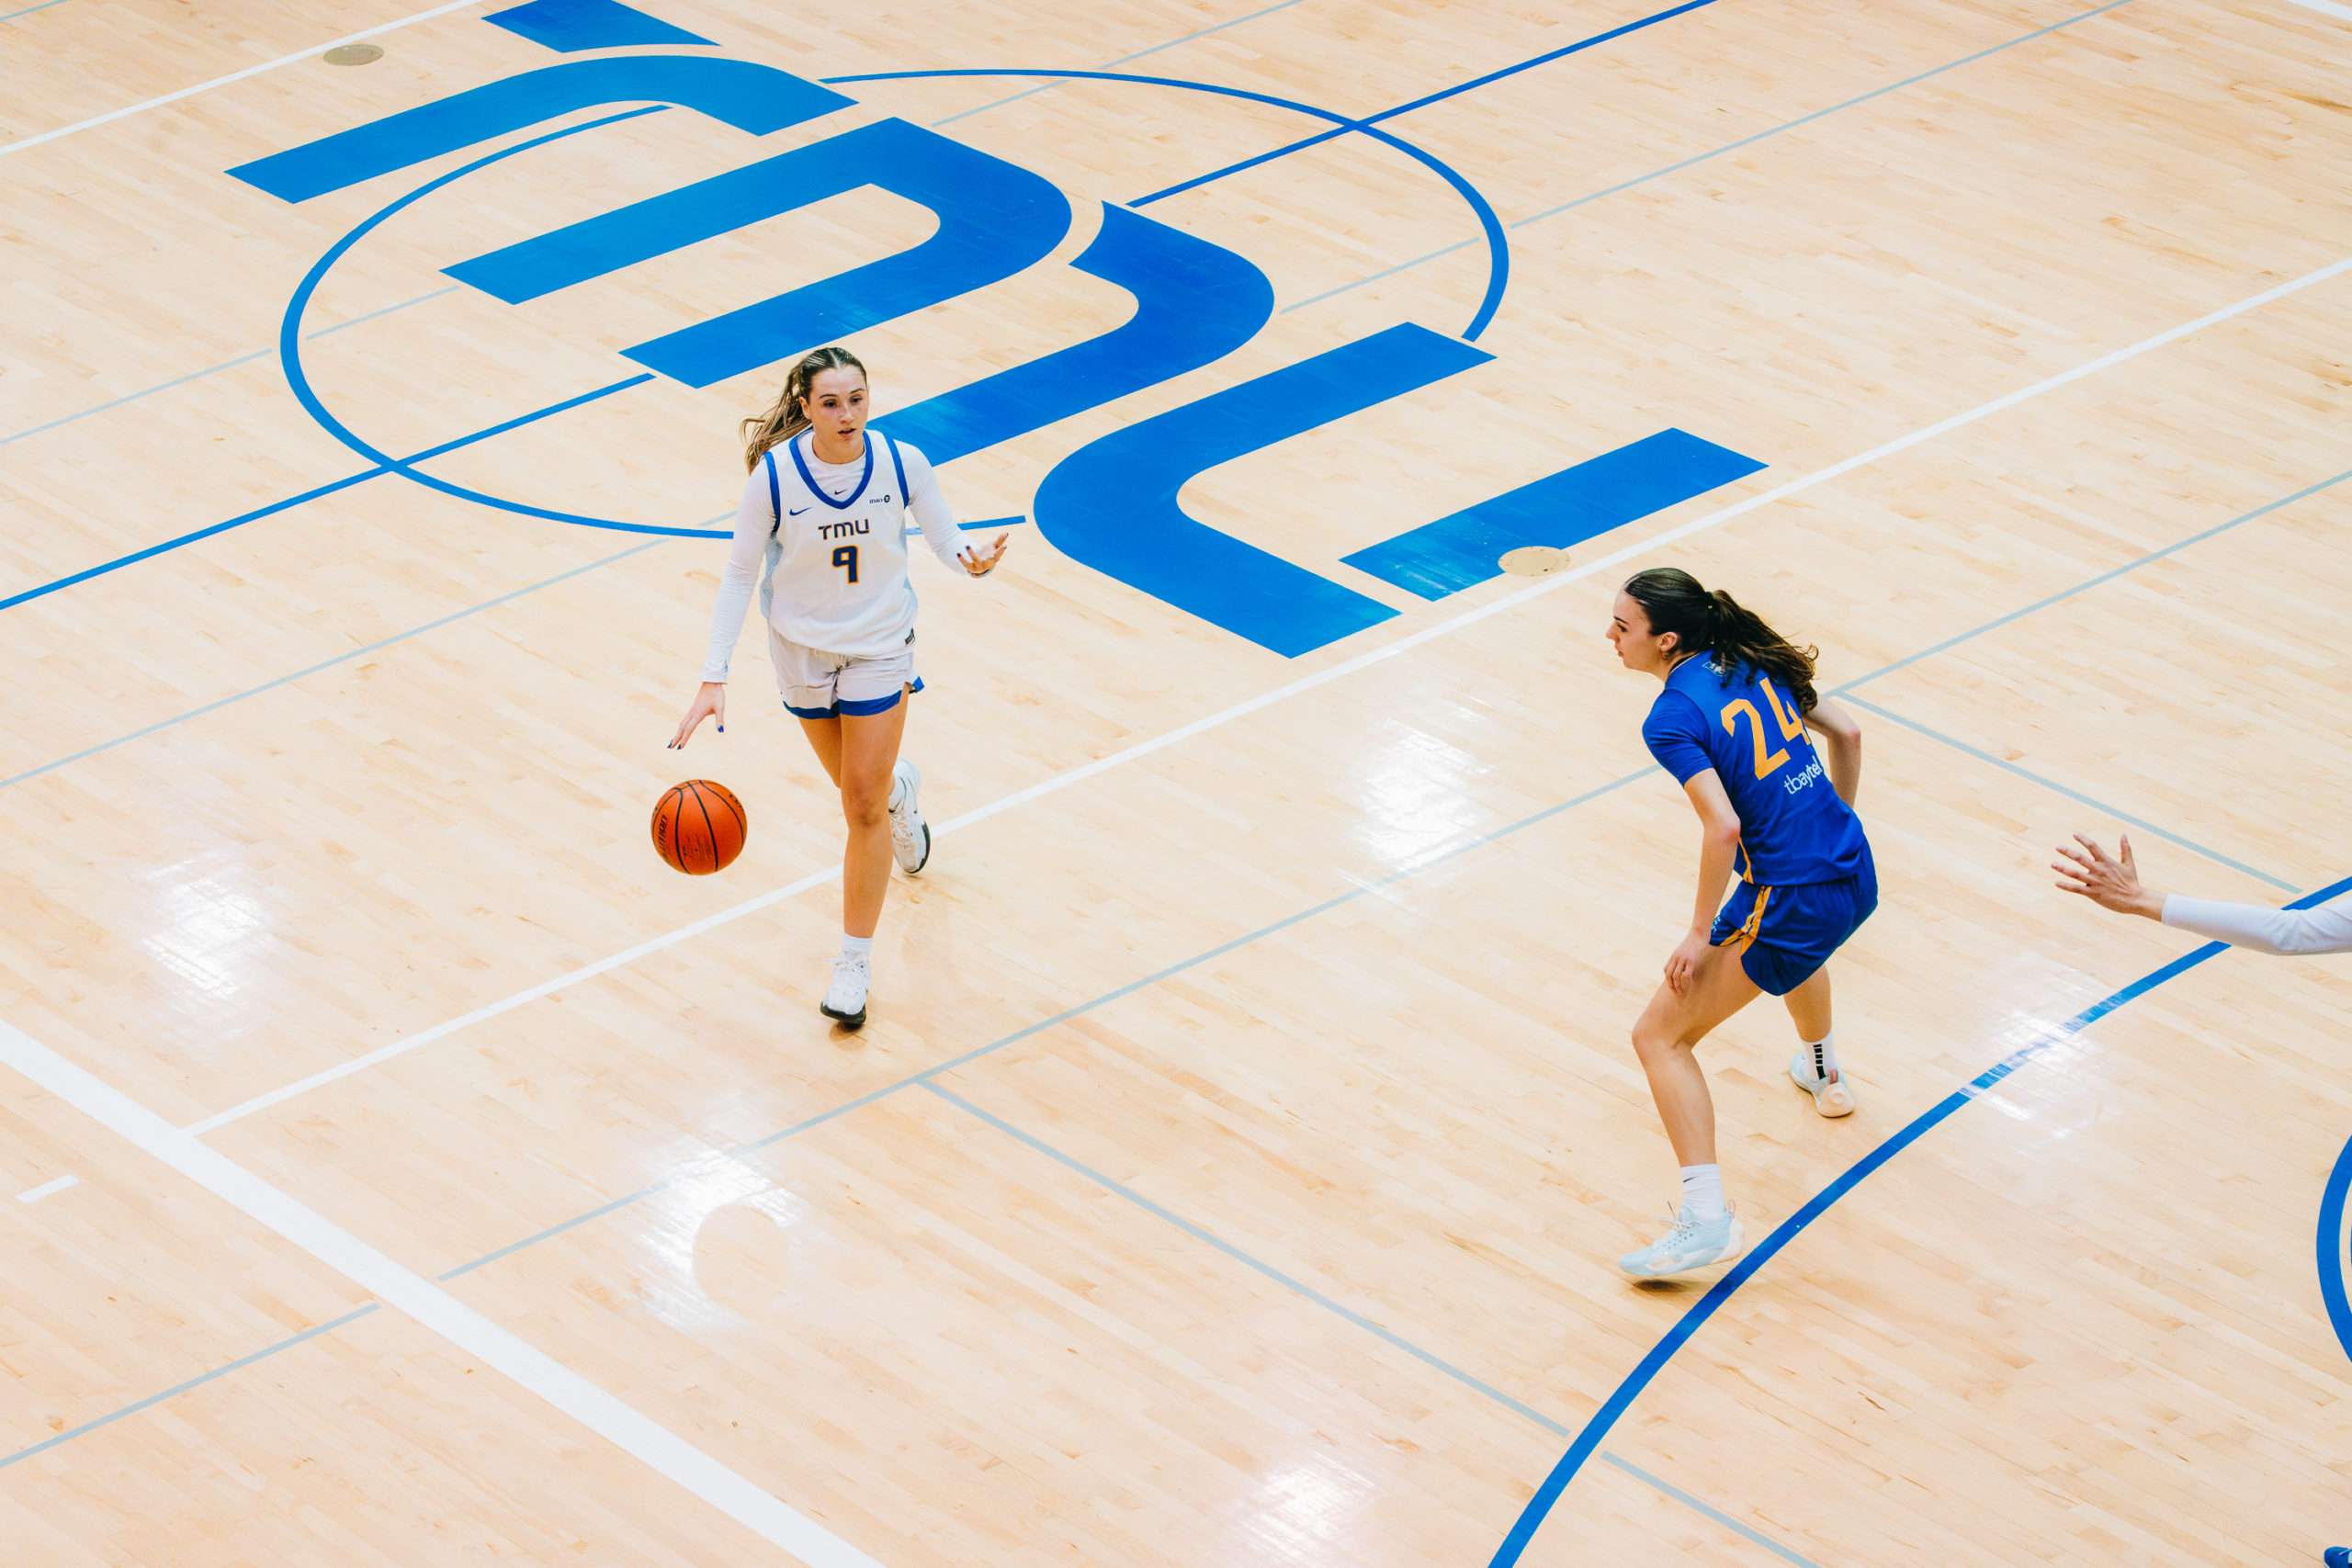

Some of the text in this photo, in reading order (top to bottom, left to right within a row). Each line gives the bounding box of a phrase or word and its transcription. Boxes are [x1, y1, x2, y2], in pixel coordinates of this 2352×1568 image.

[818, 517, 870, 541] TMU
[831, 544, 860, 585] 9
[1721, 677, 1811, 781] 24
[1784, 755, 1823, 795] tbaytel
